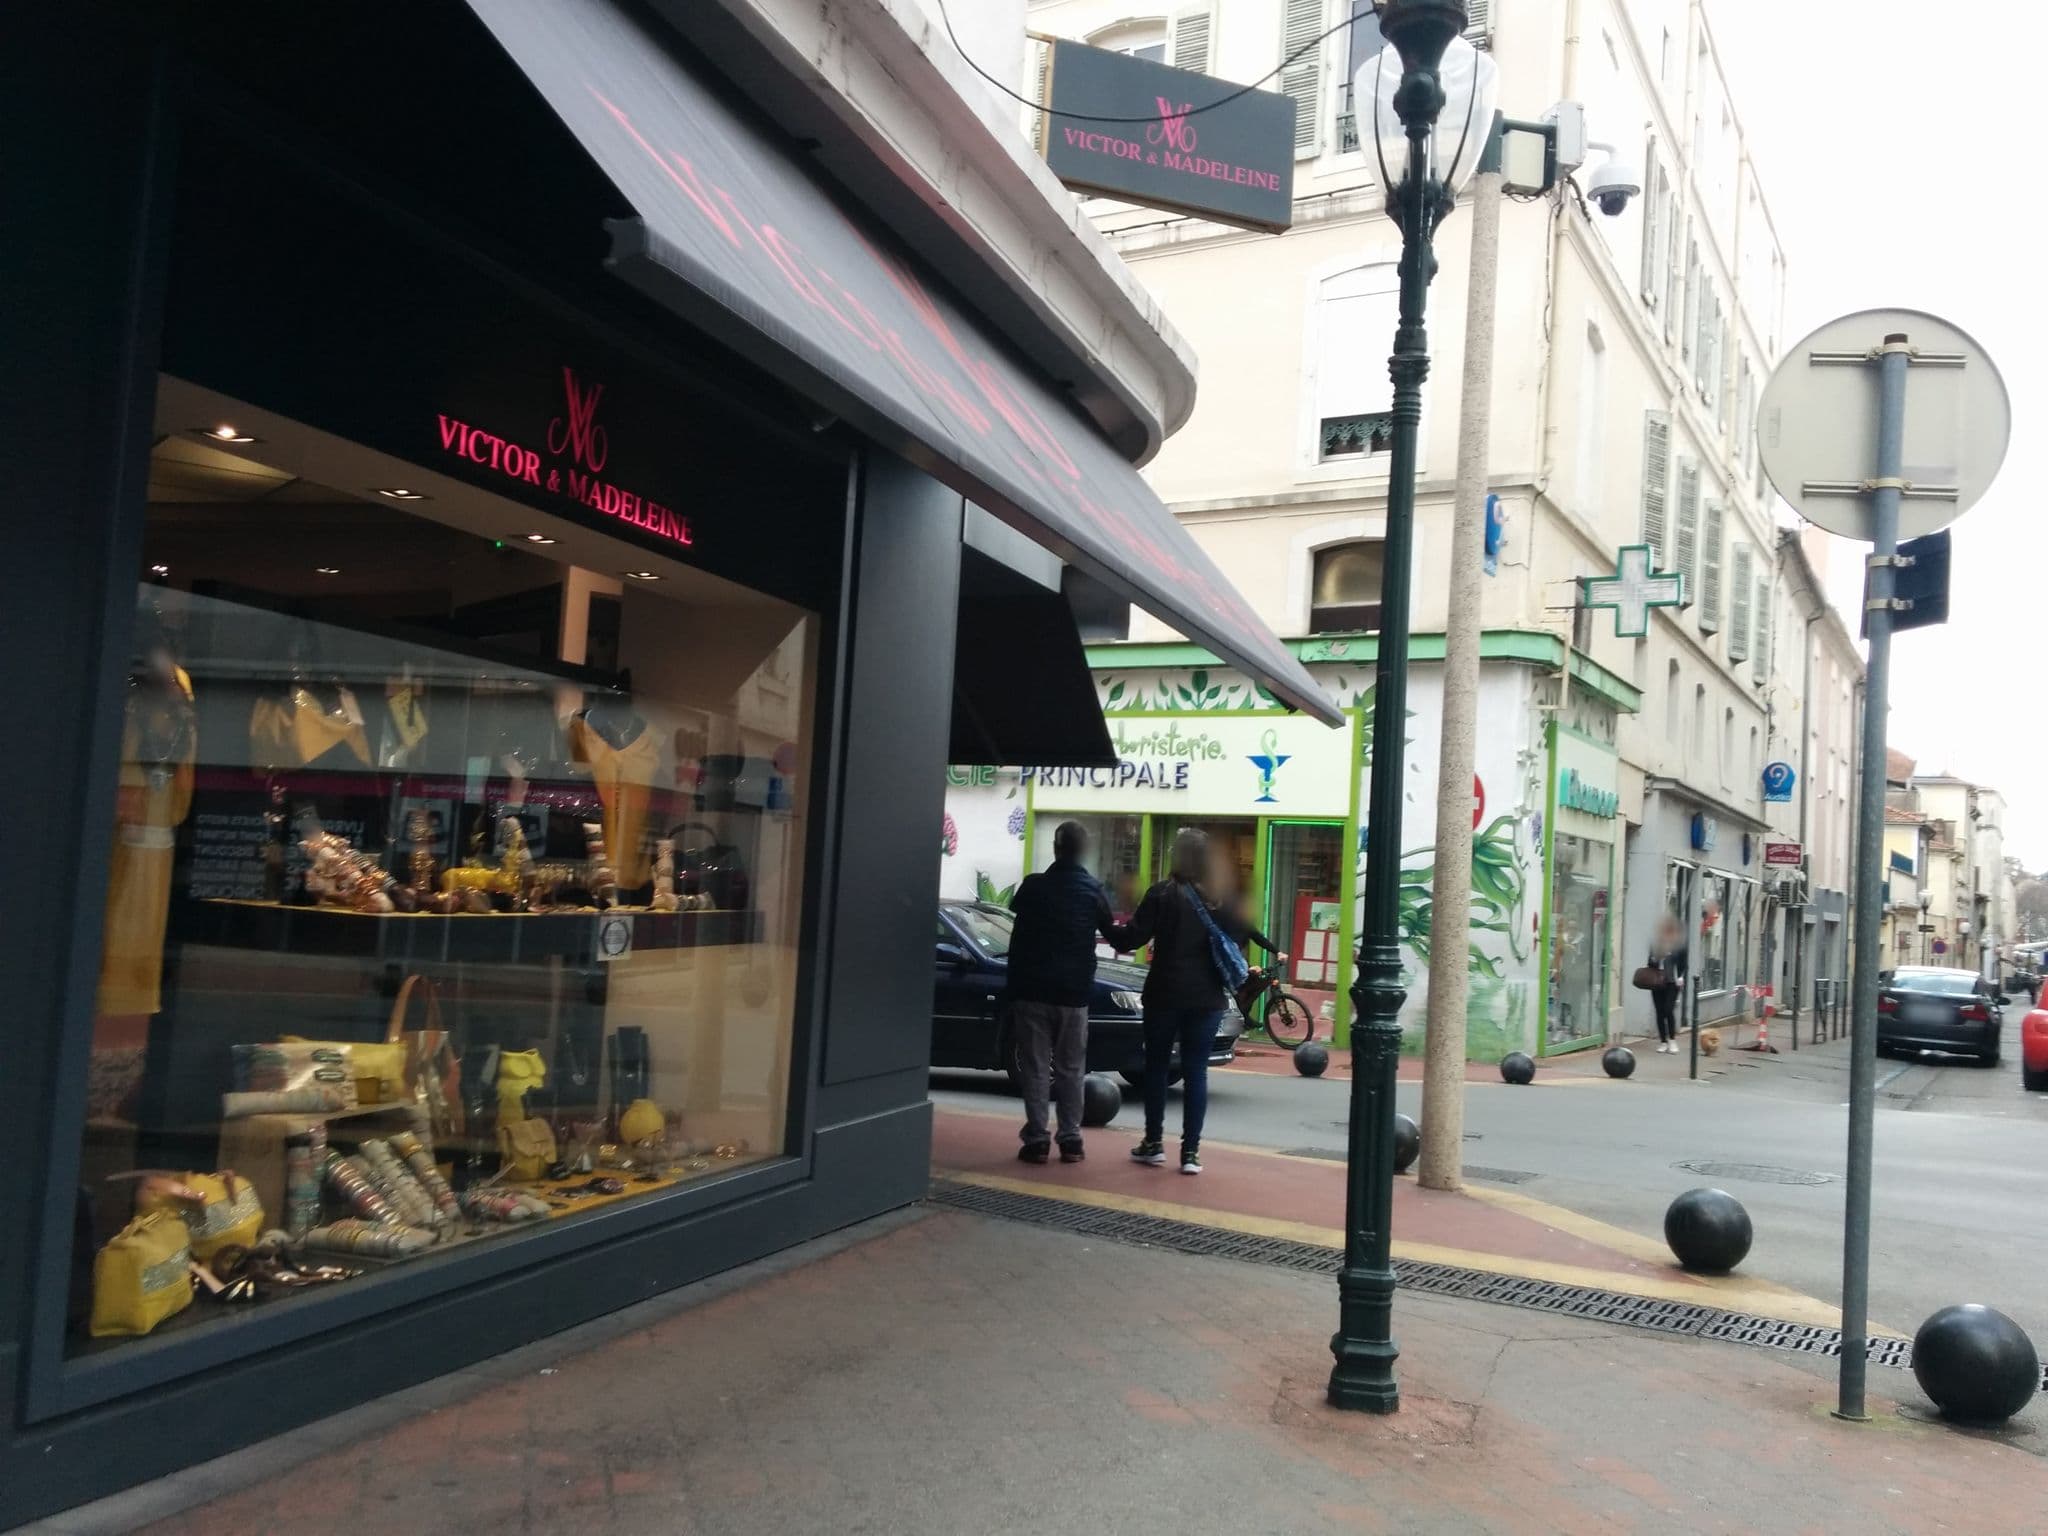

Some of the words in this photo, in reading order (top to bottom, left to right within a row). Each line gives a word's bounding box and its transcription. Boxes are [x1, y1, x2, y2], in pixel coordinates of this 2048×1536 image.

[1064, 127, 1142, 162] VICTOR
[1146, 152, 1158, 165] &
[1163, 151, 1281, 192] MADELEINE
[437, 413, 541, 486] VICTOR
[546, 469, 560, 493] &
[568, 468, 693, 546] MADELEINE
[1018, 761, 1190, 790] PRINCIPALE
